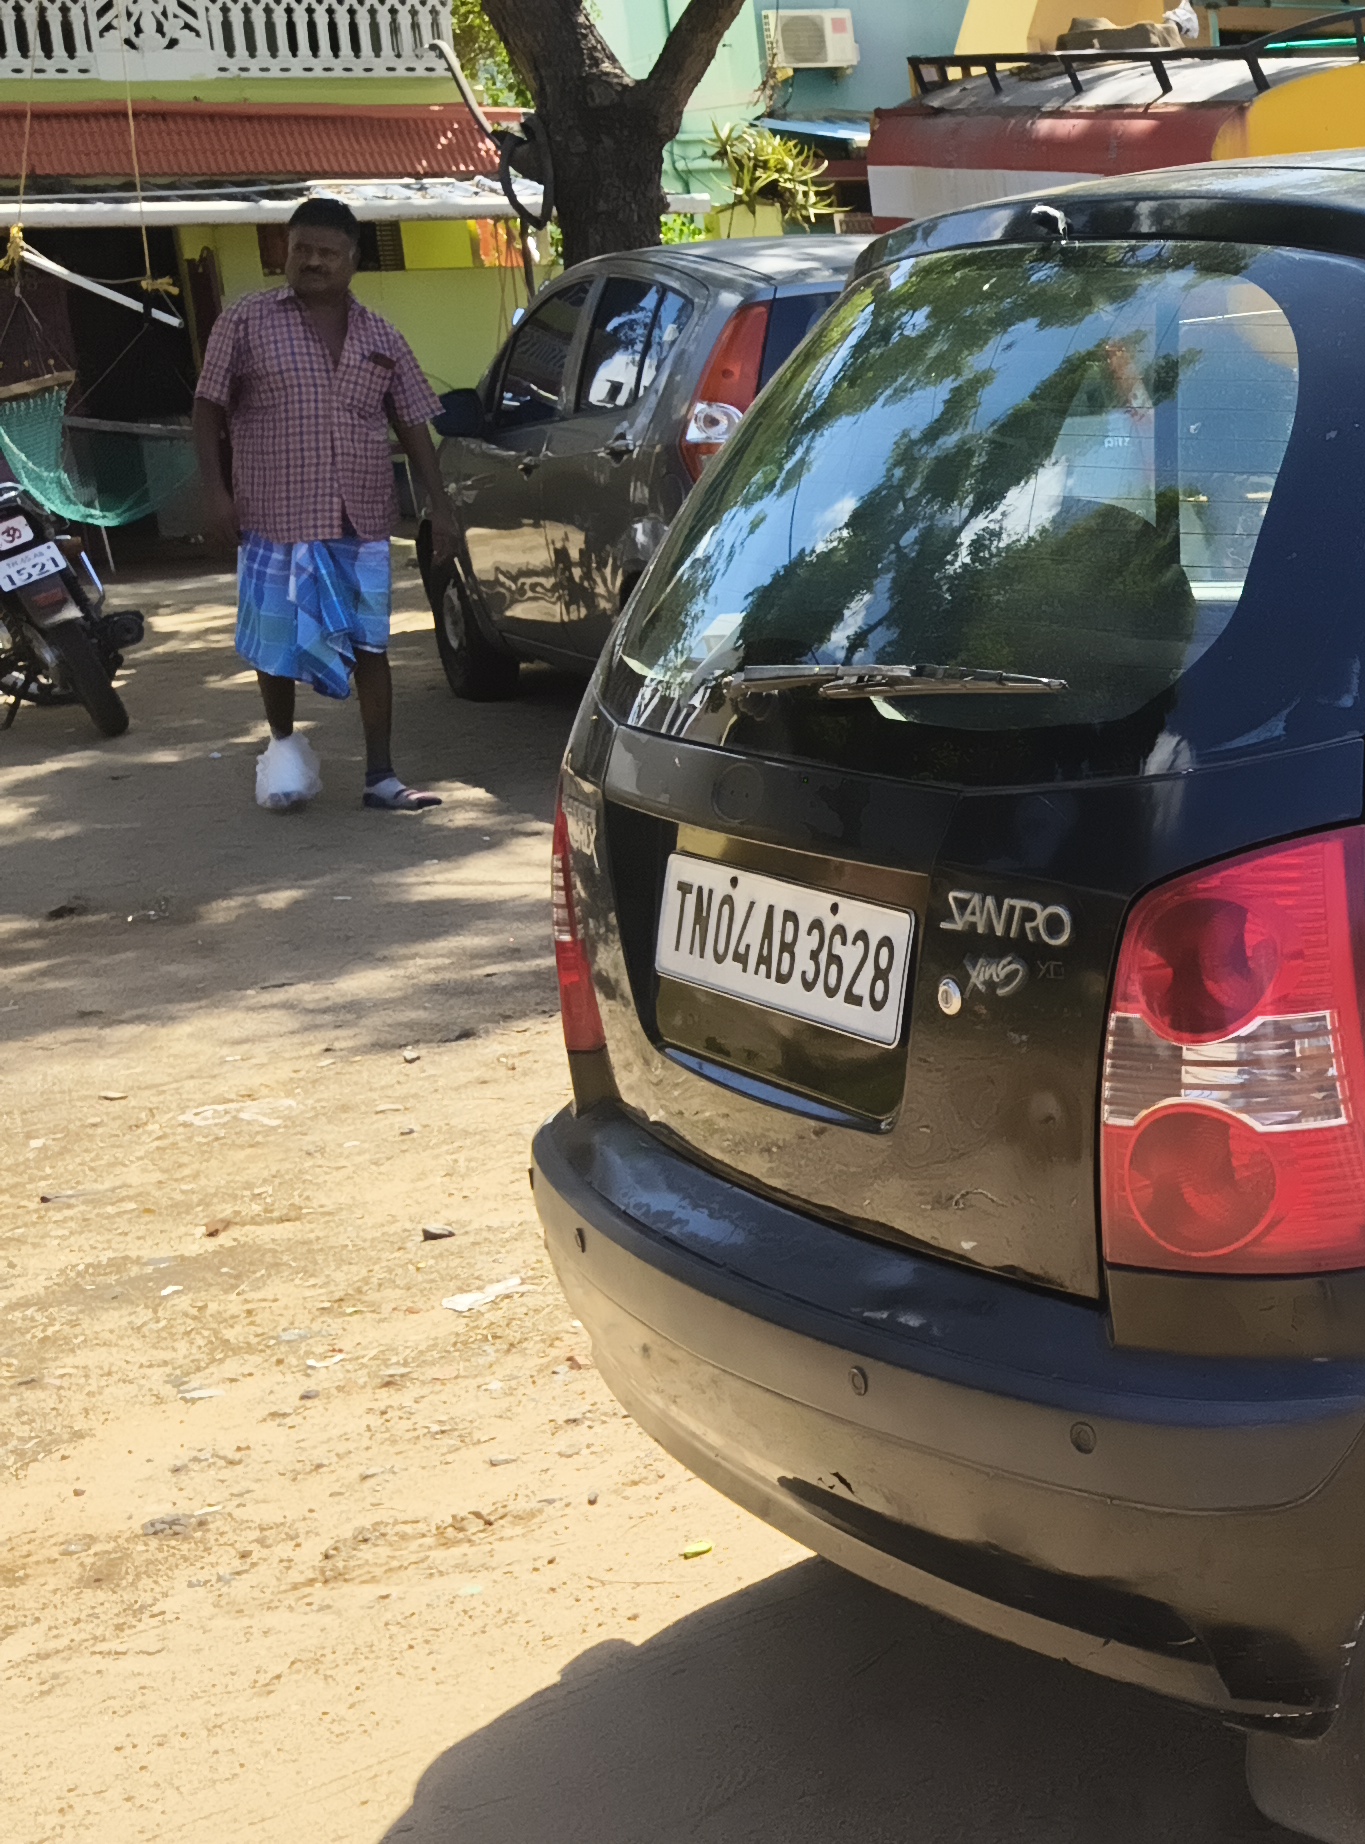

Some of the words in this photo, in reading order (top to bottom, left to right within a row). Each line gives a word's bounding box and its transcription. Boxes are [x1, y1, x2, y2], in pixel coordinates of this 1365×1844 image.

[2, 556, 60, 586] 1521
[674, 880, 895, 1012] TN04AB3628
[939, 888, 1072, 946] SANTRO
